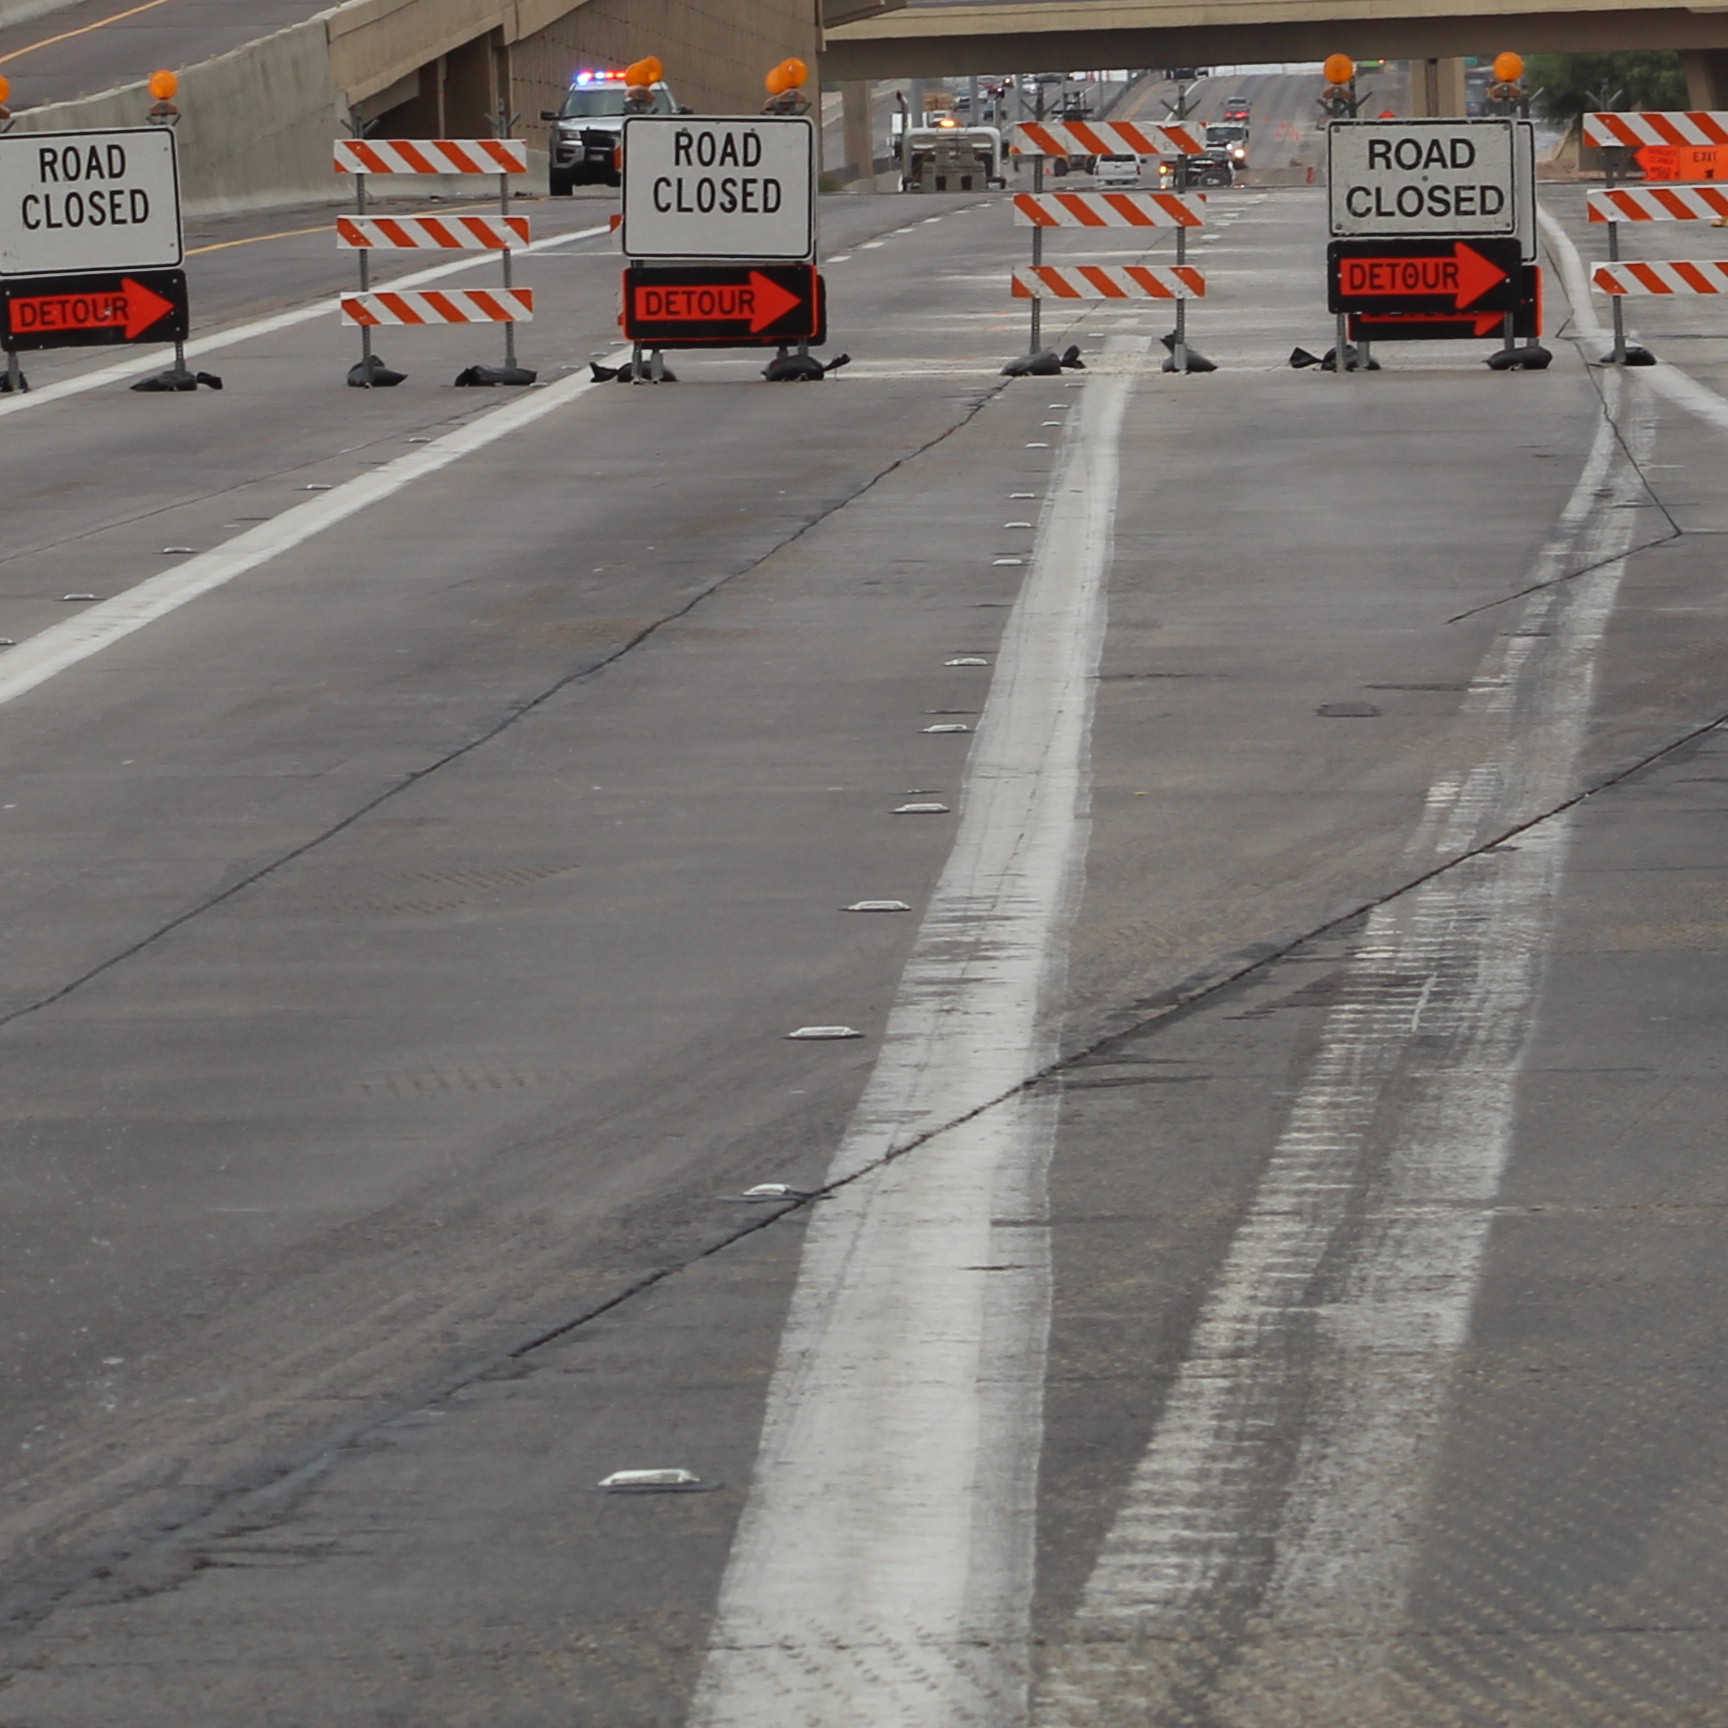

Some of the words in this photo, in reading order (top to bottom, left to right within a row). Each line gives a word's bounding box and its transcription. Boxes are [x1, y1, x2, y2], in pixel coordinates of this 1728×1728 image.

[39, 145, 126, 183] ROAD
[675, 132, 762, 167] ROAD
[1368, 138, 1476, 170] ROAD
[1693, 151, 1717, 162] EXIT
[22, 189, 149, 229] CLOSED
[653, 177, 781, 213] CLOSED
[1346, 185, 1504, 217] CLOSED
[1349, 263, 1460, 290] DETOUR
[19, 297, 129, 327] DETOUR
[645, 290, 755, 316] DETOUR
